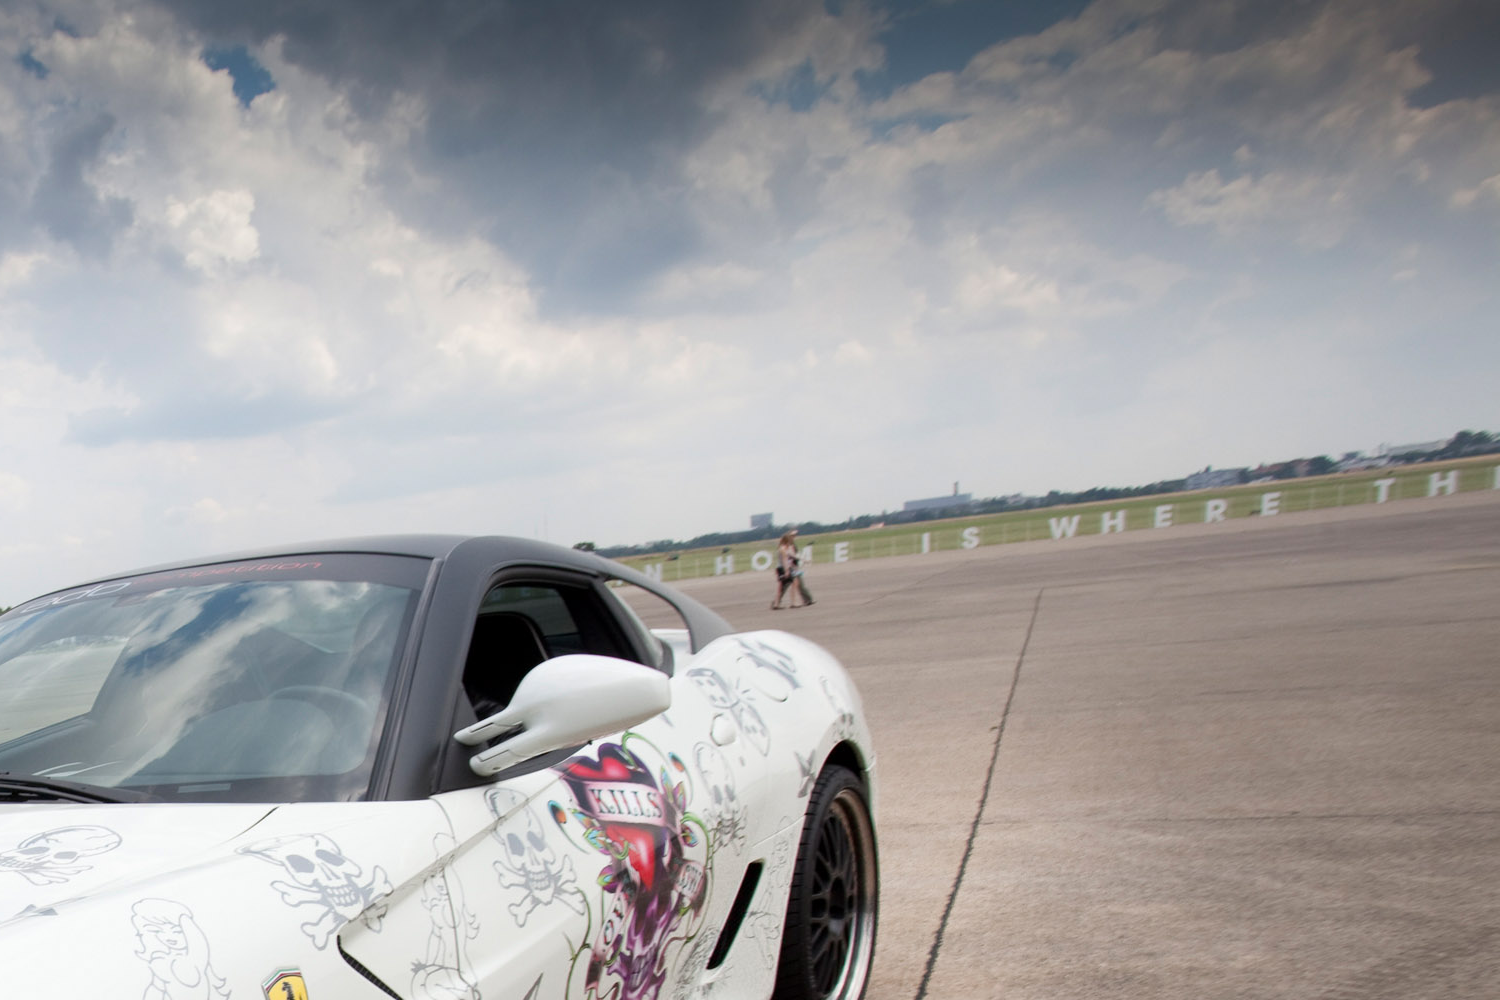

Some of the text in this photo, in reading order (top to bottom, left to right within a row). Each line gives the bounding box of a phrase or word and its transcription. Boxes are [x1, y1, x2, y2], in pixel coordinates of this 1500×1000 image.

[921, 527, 980, 553] IS
[1049, 491, 1282, 540] WHERE
[1373, 464, 1500, 504] TH
